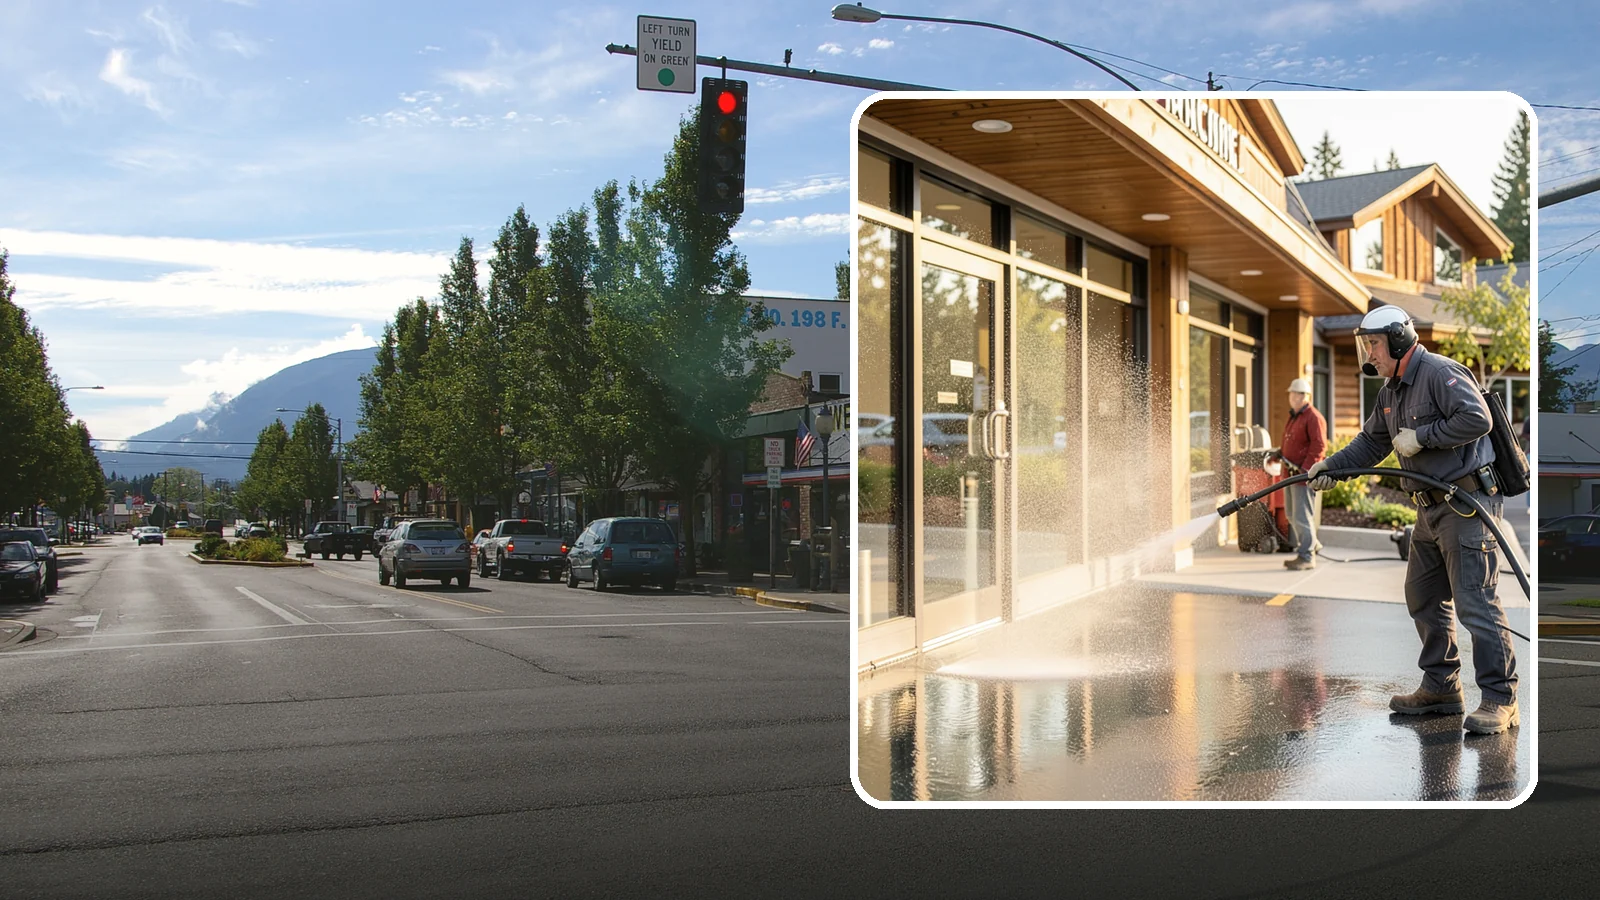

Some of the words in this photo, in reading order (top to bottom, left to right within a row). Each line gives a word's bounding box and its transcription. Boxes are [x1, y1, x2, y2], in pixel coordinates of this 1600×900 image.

[643, 24, 663, 34] LEFT
[668, 26, 690, 36] TURN
[652, 38, 682, 51] YIELD
[644, 53, 656, 63] ON
[661, 55, 688, 66] GREEN
[791, 309, 826, 328] 198
[831, 311, 846, 329] F.
